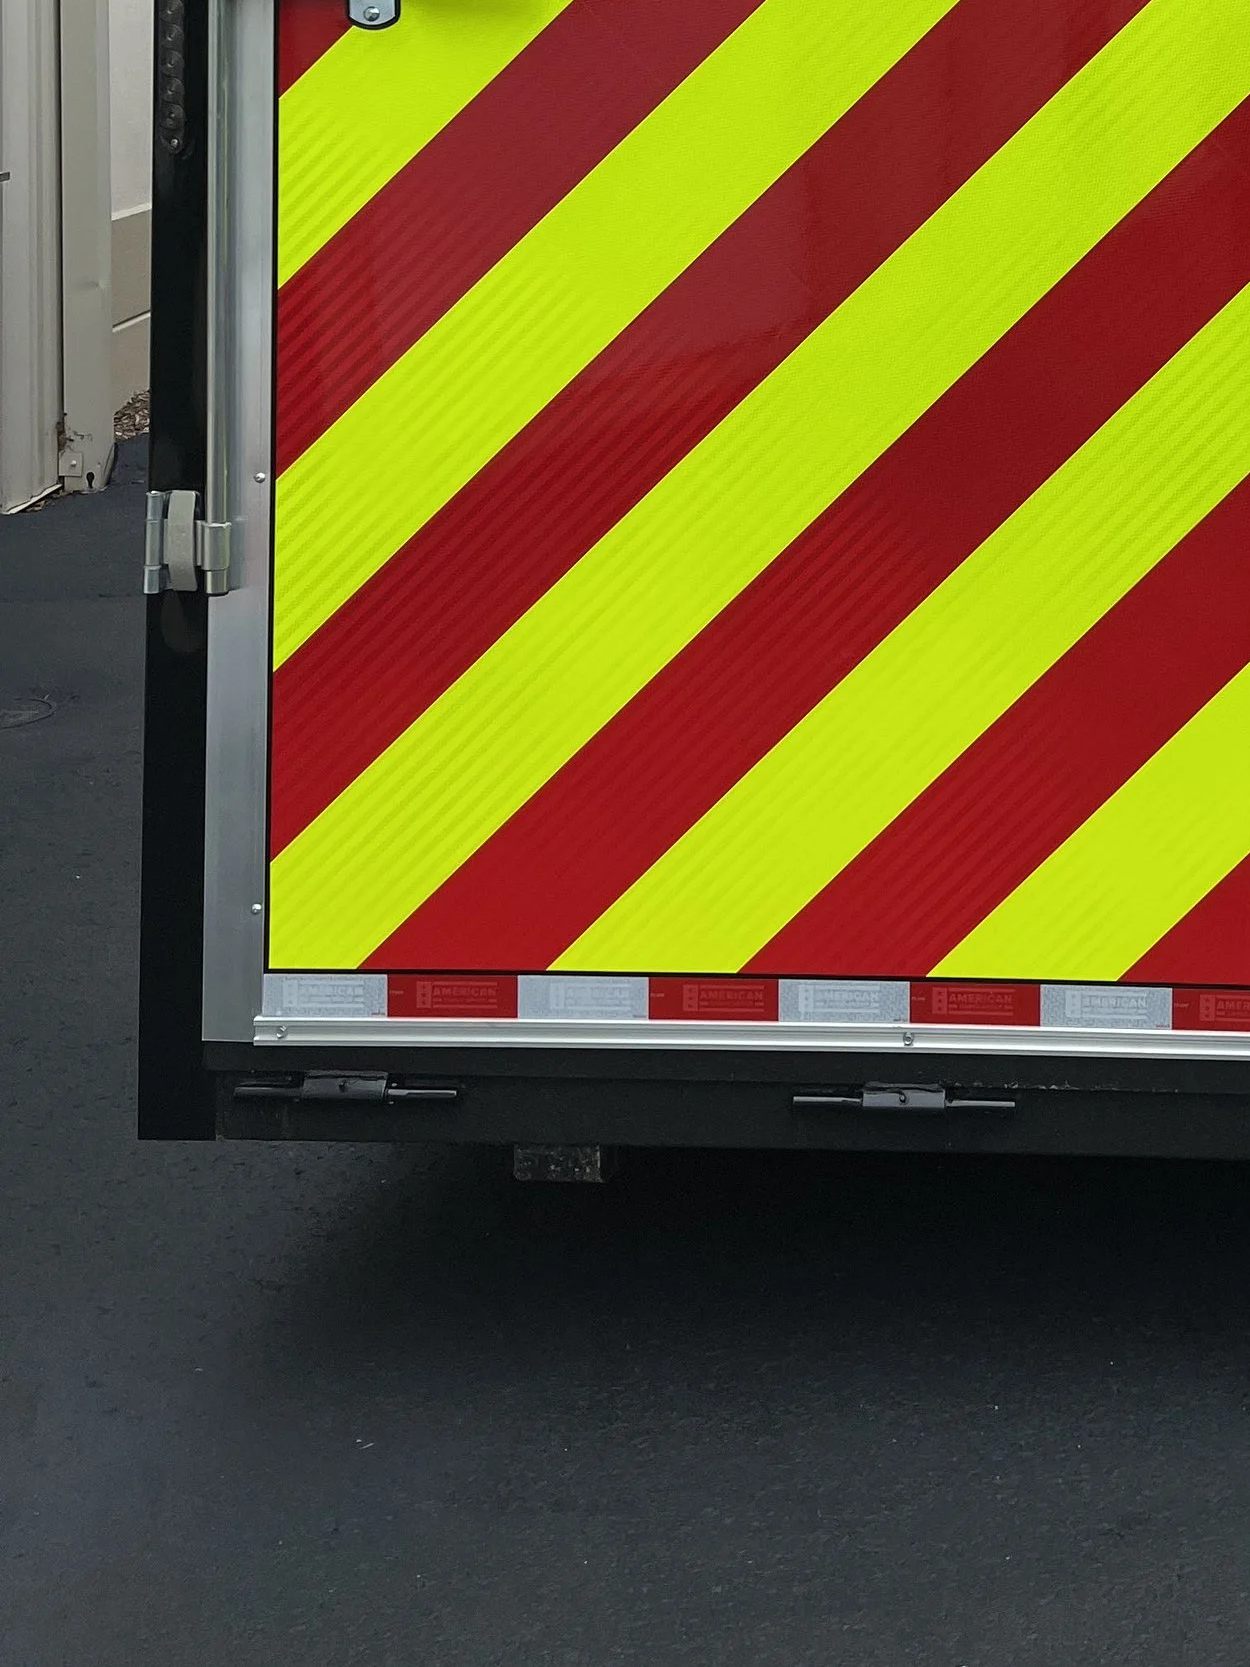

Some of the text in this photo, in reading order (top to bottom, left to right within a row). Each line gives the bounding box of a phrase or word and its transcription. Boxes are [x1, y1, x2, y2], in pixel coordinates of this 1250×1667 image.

[300, 985, 363, 995] AMICAN
[700, 990, 763, 1000] AMERICAN
[949, 994, 1012, 1003] AMERICAN
[1082, 997, 1146, 1007] MERICAN
